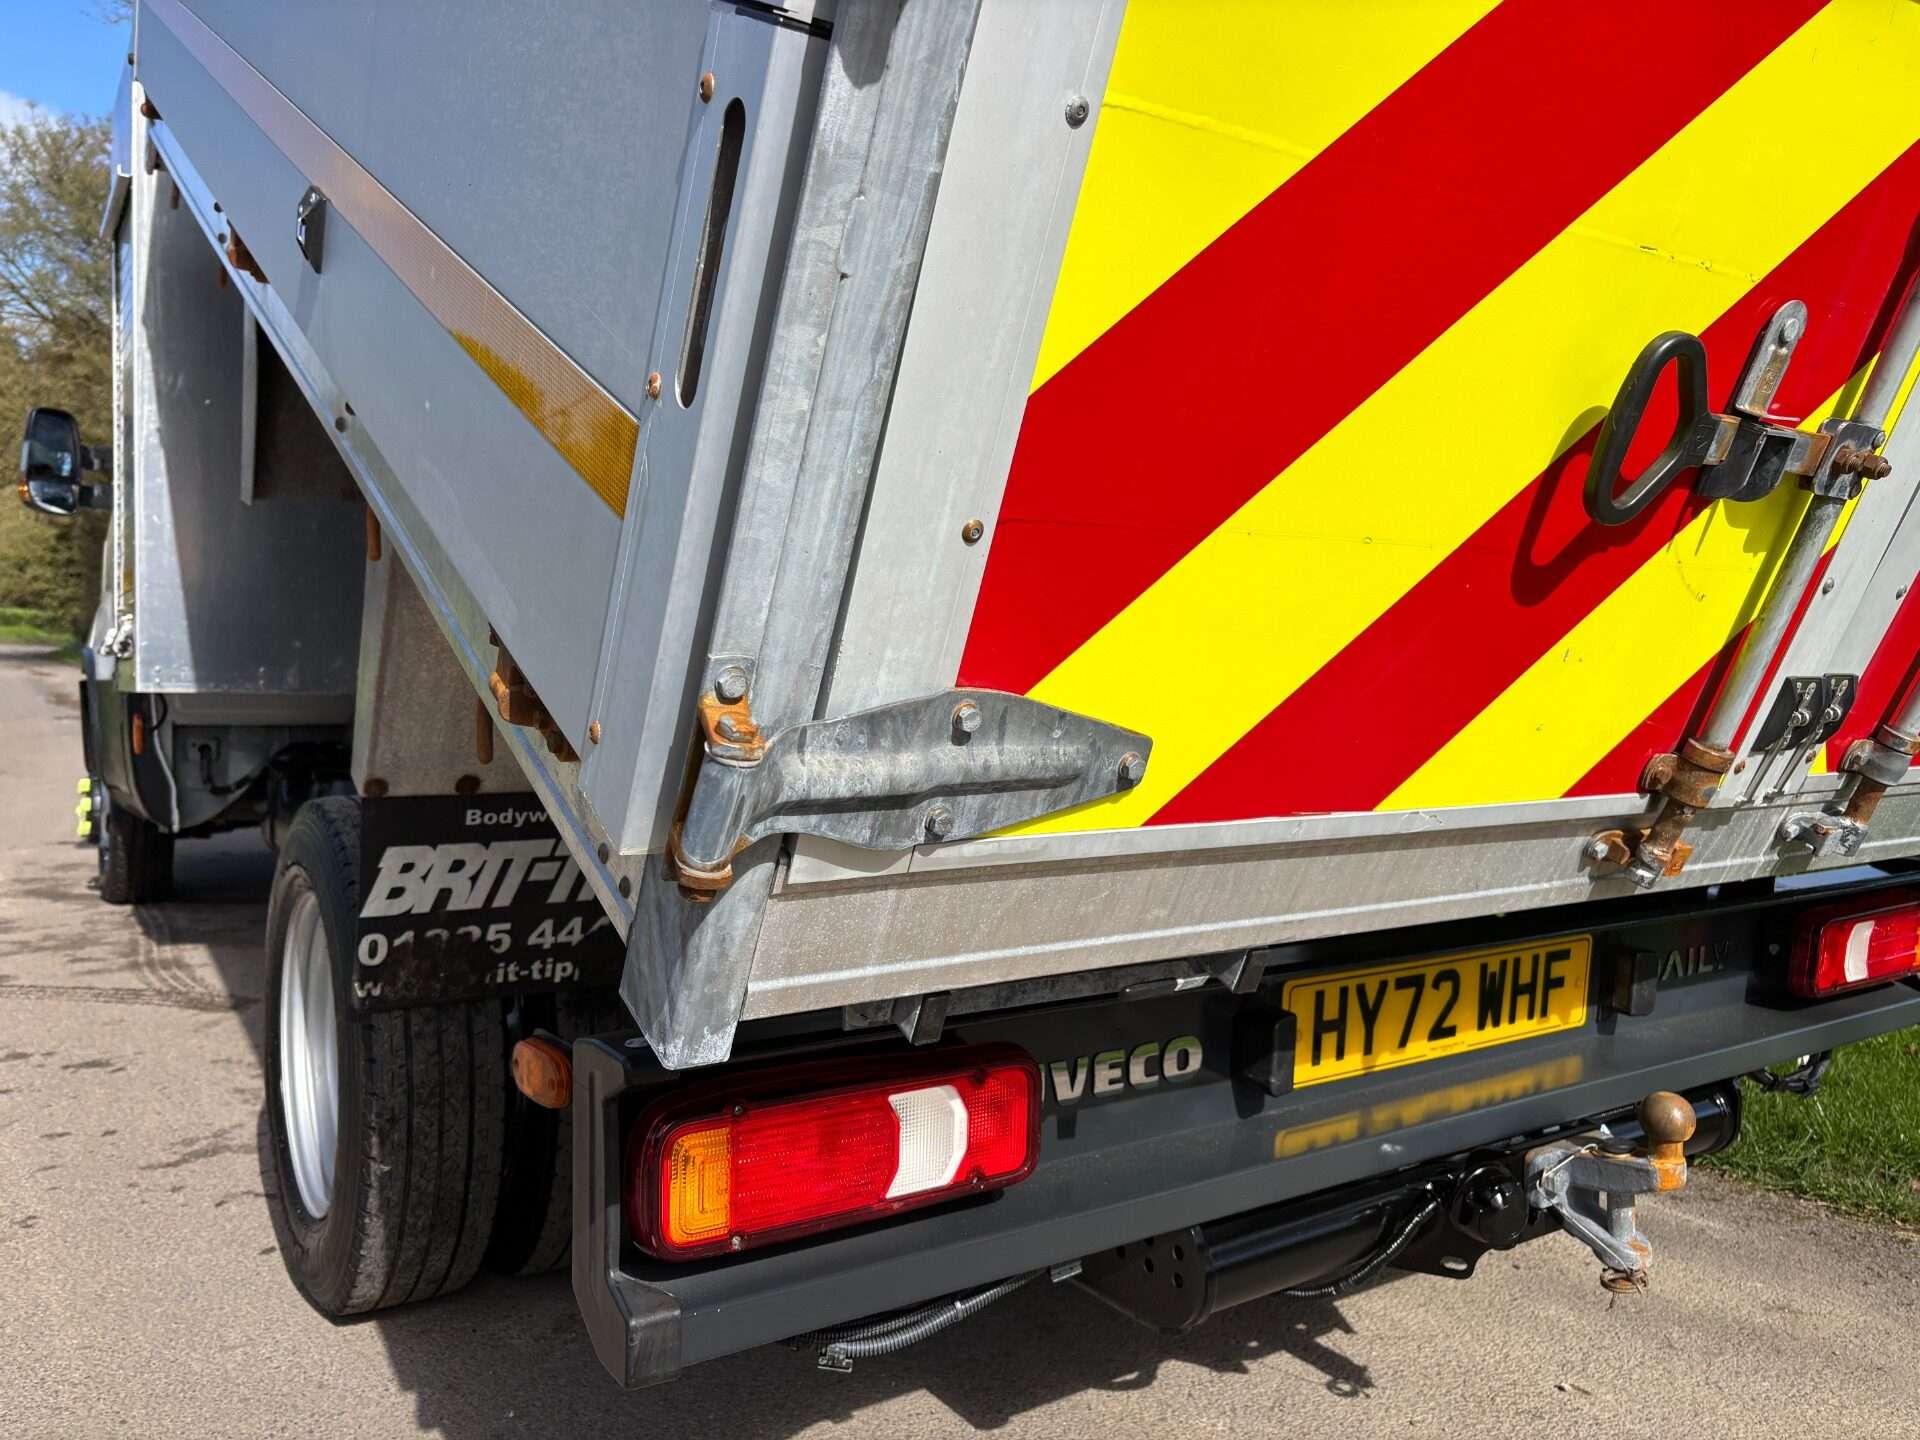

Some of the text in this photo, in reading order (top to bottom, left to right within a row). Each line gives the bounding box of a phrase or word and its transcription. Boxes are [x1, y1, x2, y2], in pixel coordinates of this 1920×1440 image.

[1656, 938, 1730, 980] AILY
[1311, 948, 1572, 1067] HY72 WHF
